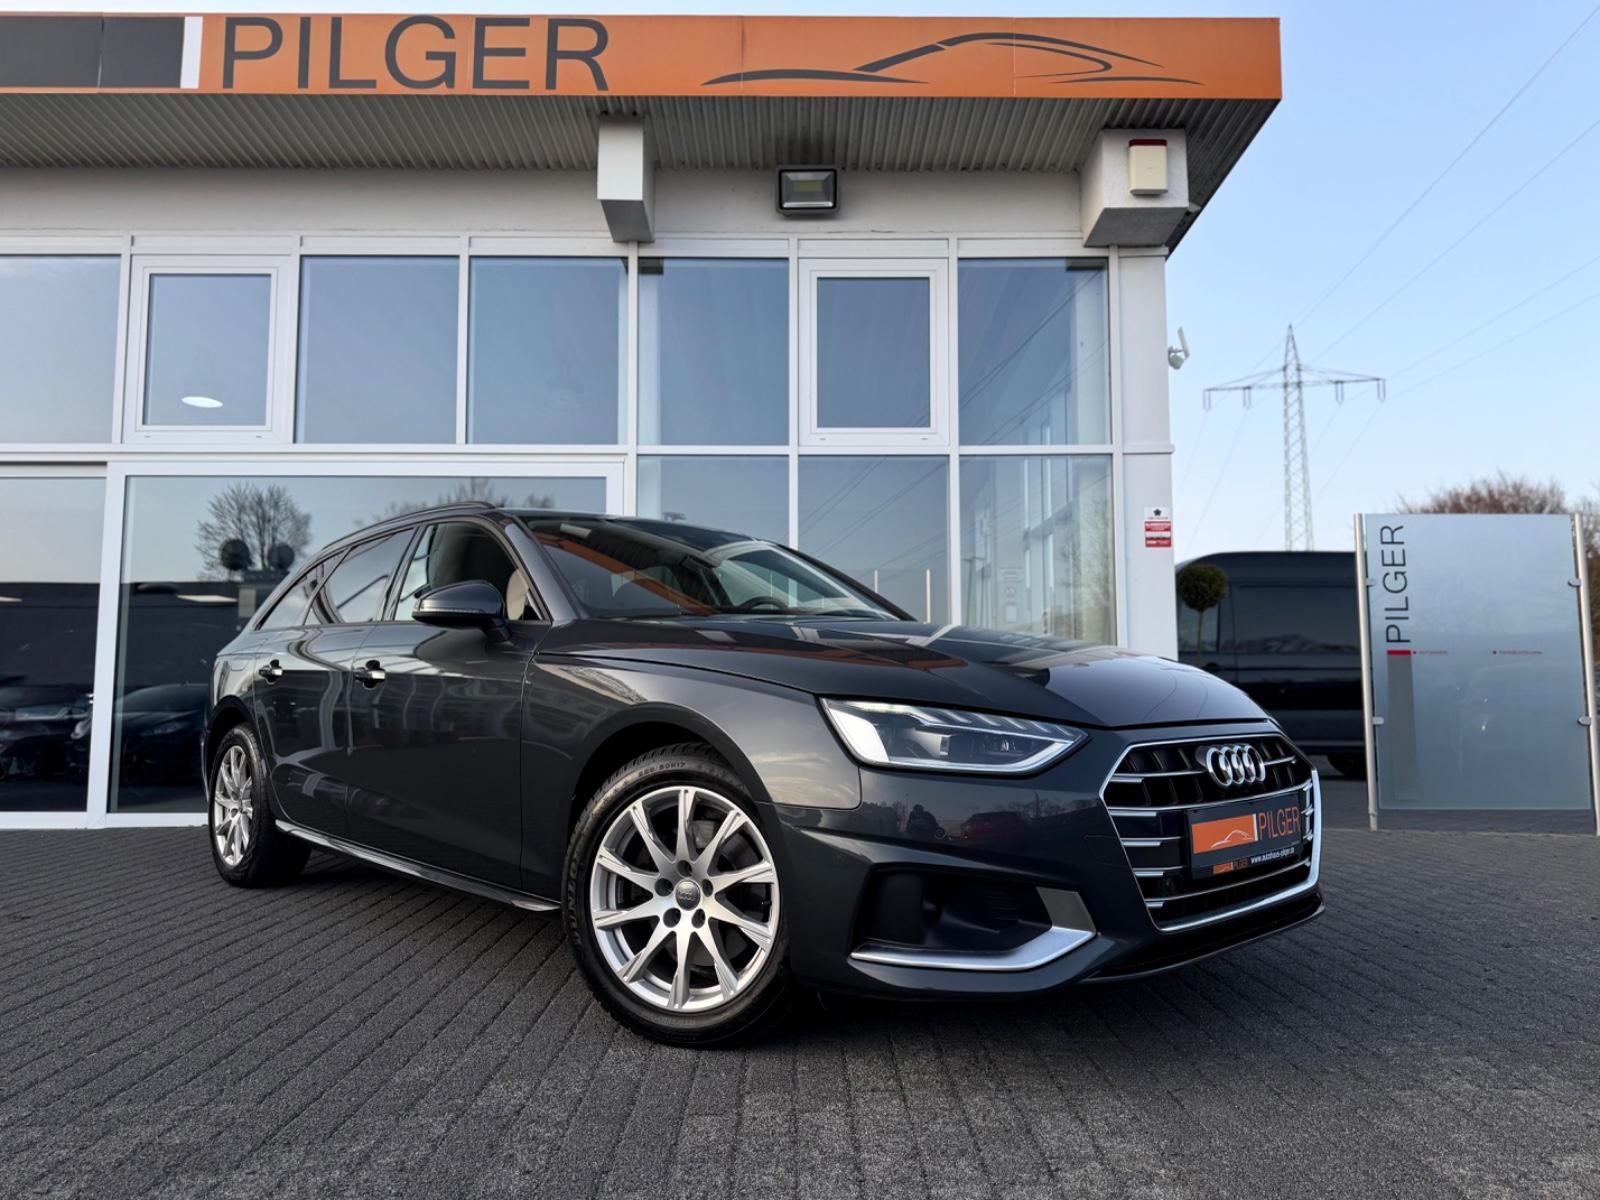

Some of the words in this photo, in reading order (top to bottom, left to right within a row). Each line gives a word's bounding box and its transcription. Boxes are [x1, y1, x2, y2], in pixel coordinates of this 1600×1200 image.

[222, 15, 609, 91] PILGER
[1380, 525, 1411, 643] PILGER
[1258, 806, 1302, 840] PILGER
